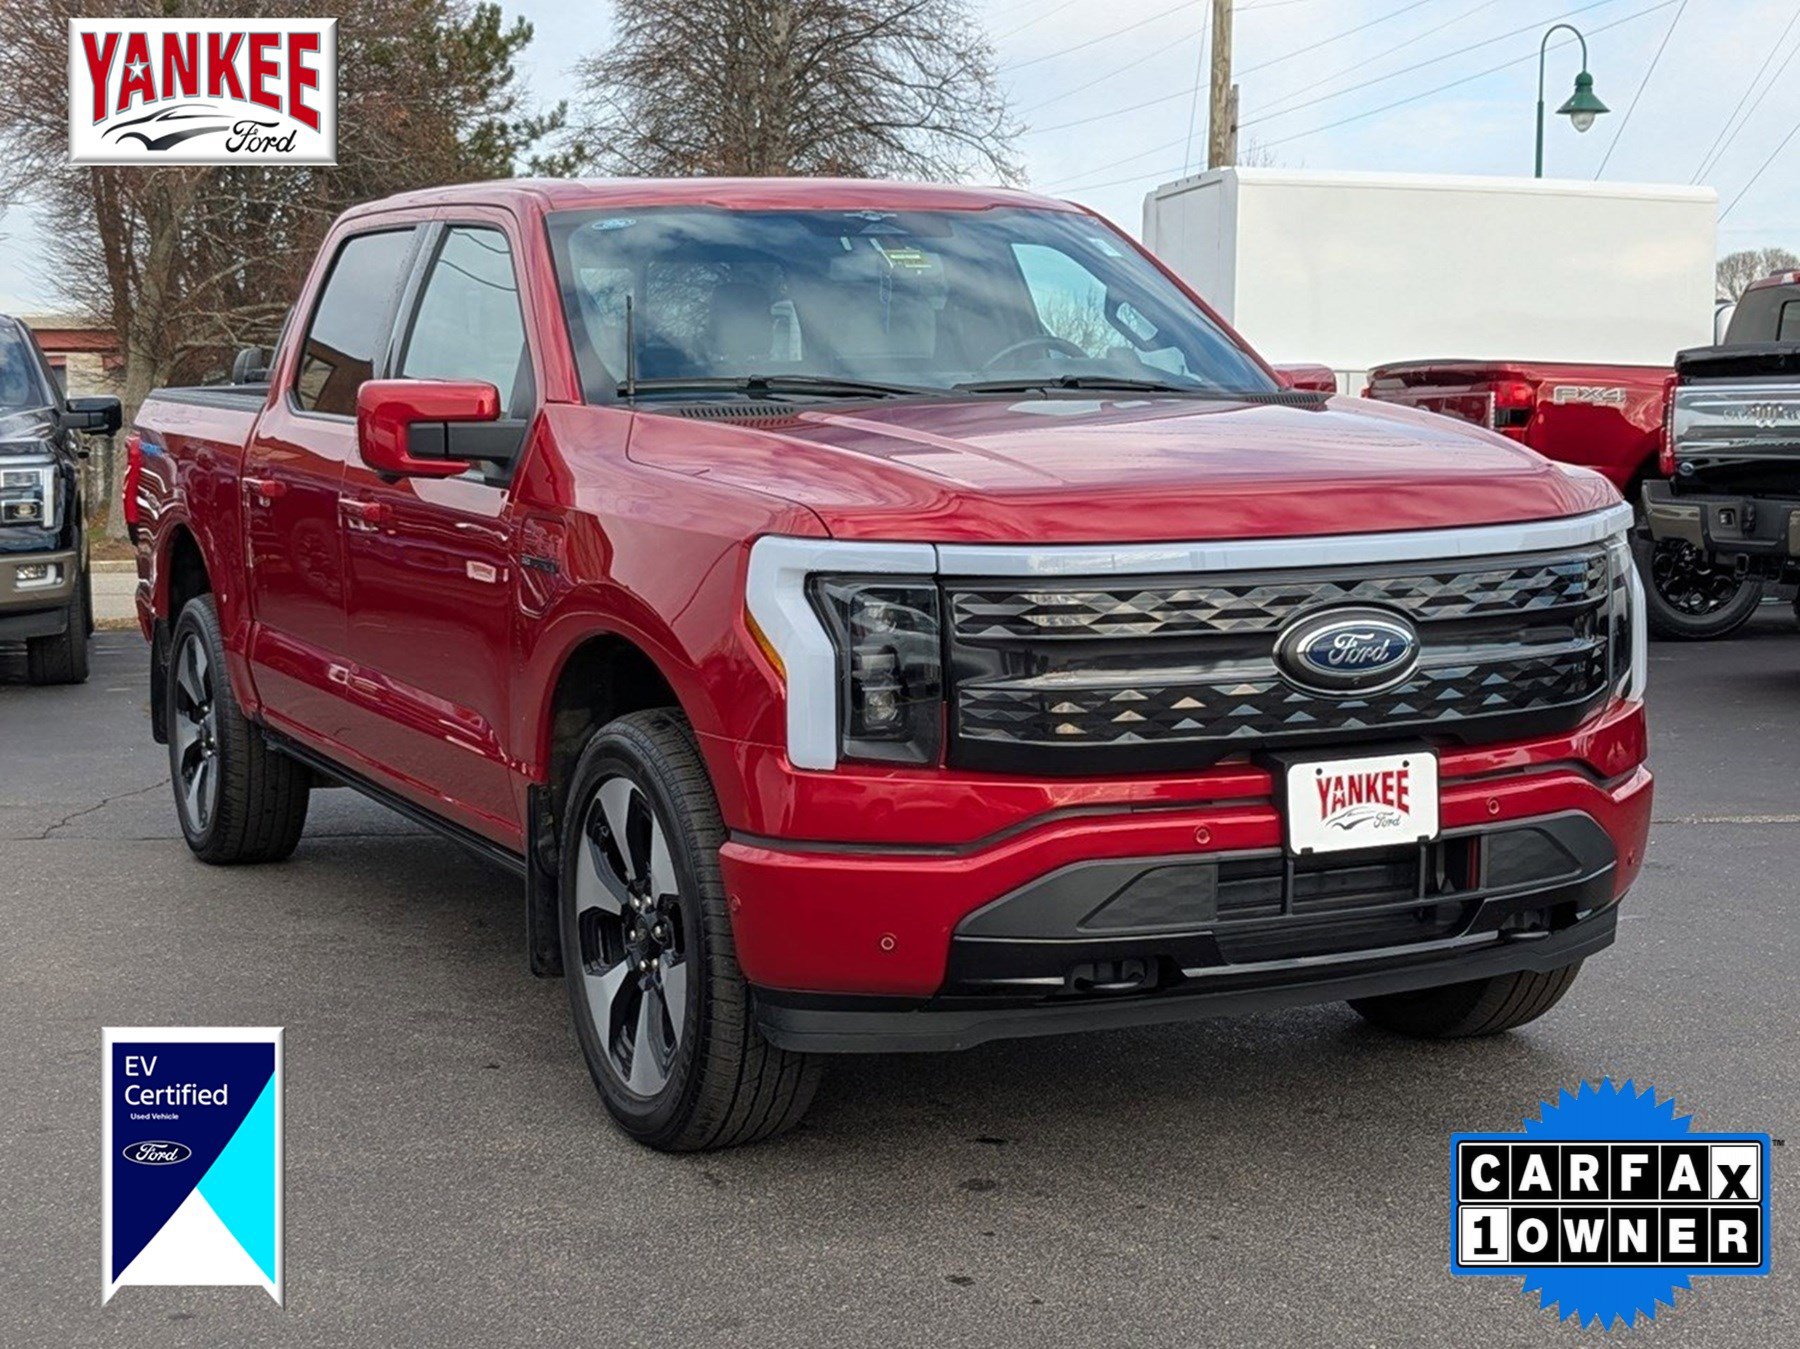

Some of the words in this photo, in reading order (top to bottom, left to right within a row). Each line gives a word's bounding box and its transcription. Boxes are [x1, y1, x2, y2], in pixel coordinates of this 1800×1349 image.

[1554, 385, 1627, 410] FX4
[1328, 633, 1391, 665] Ford
[1316, 769, 1410, 821] YANKEE
[1373, 811, 1402, 828] Ford
